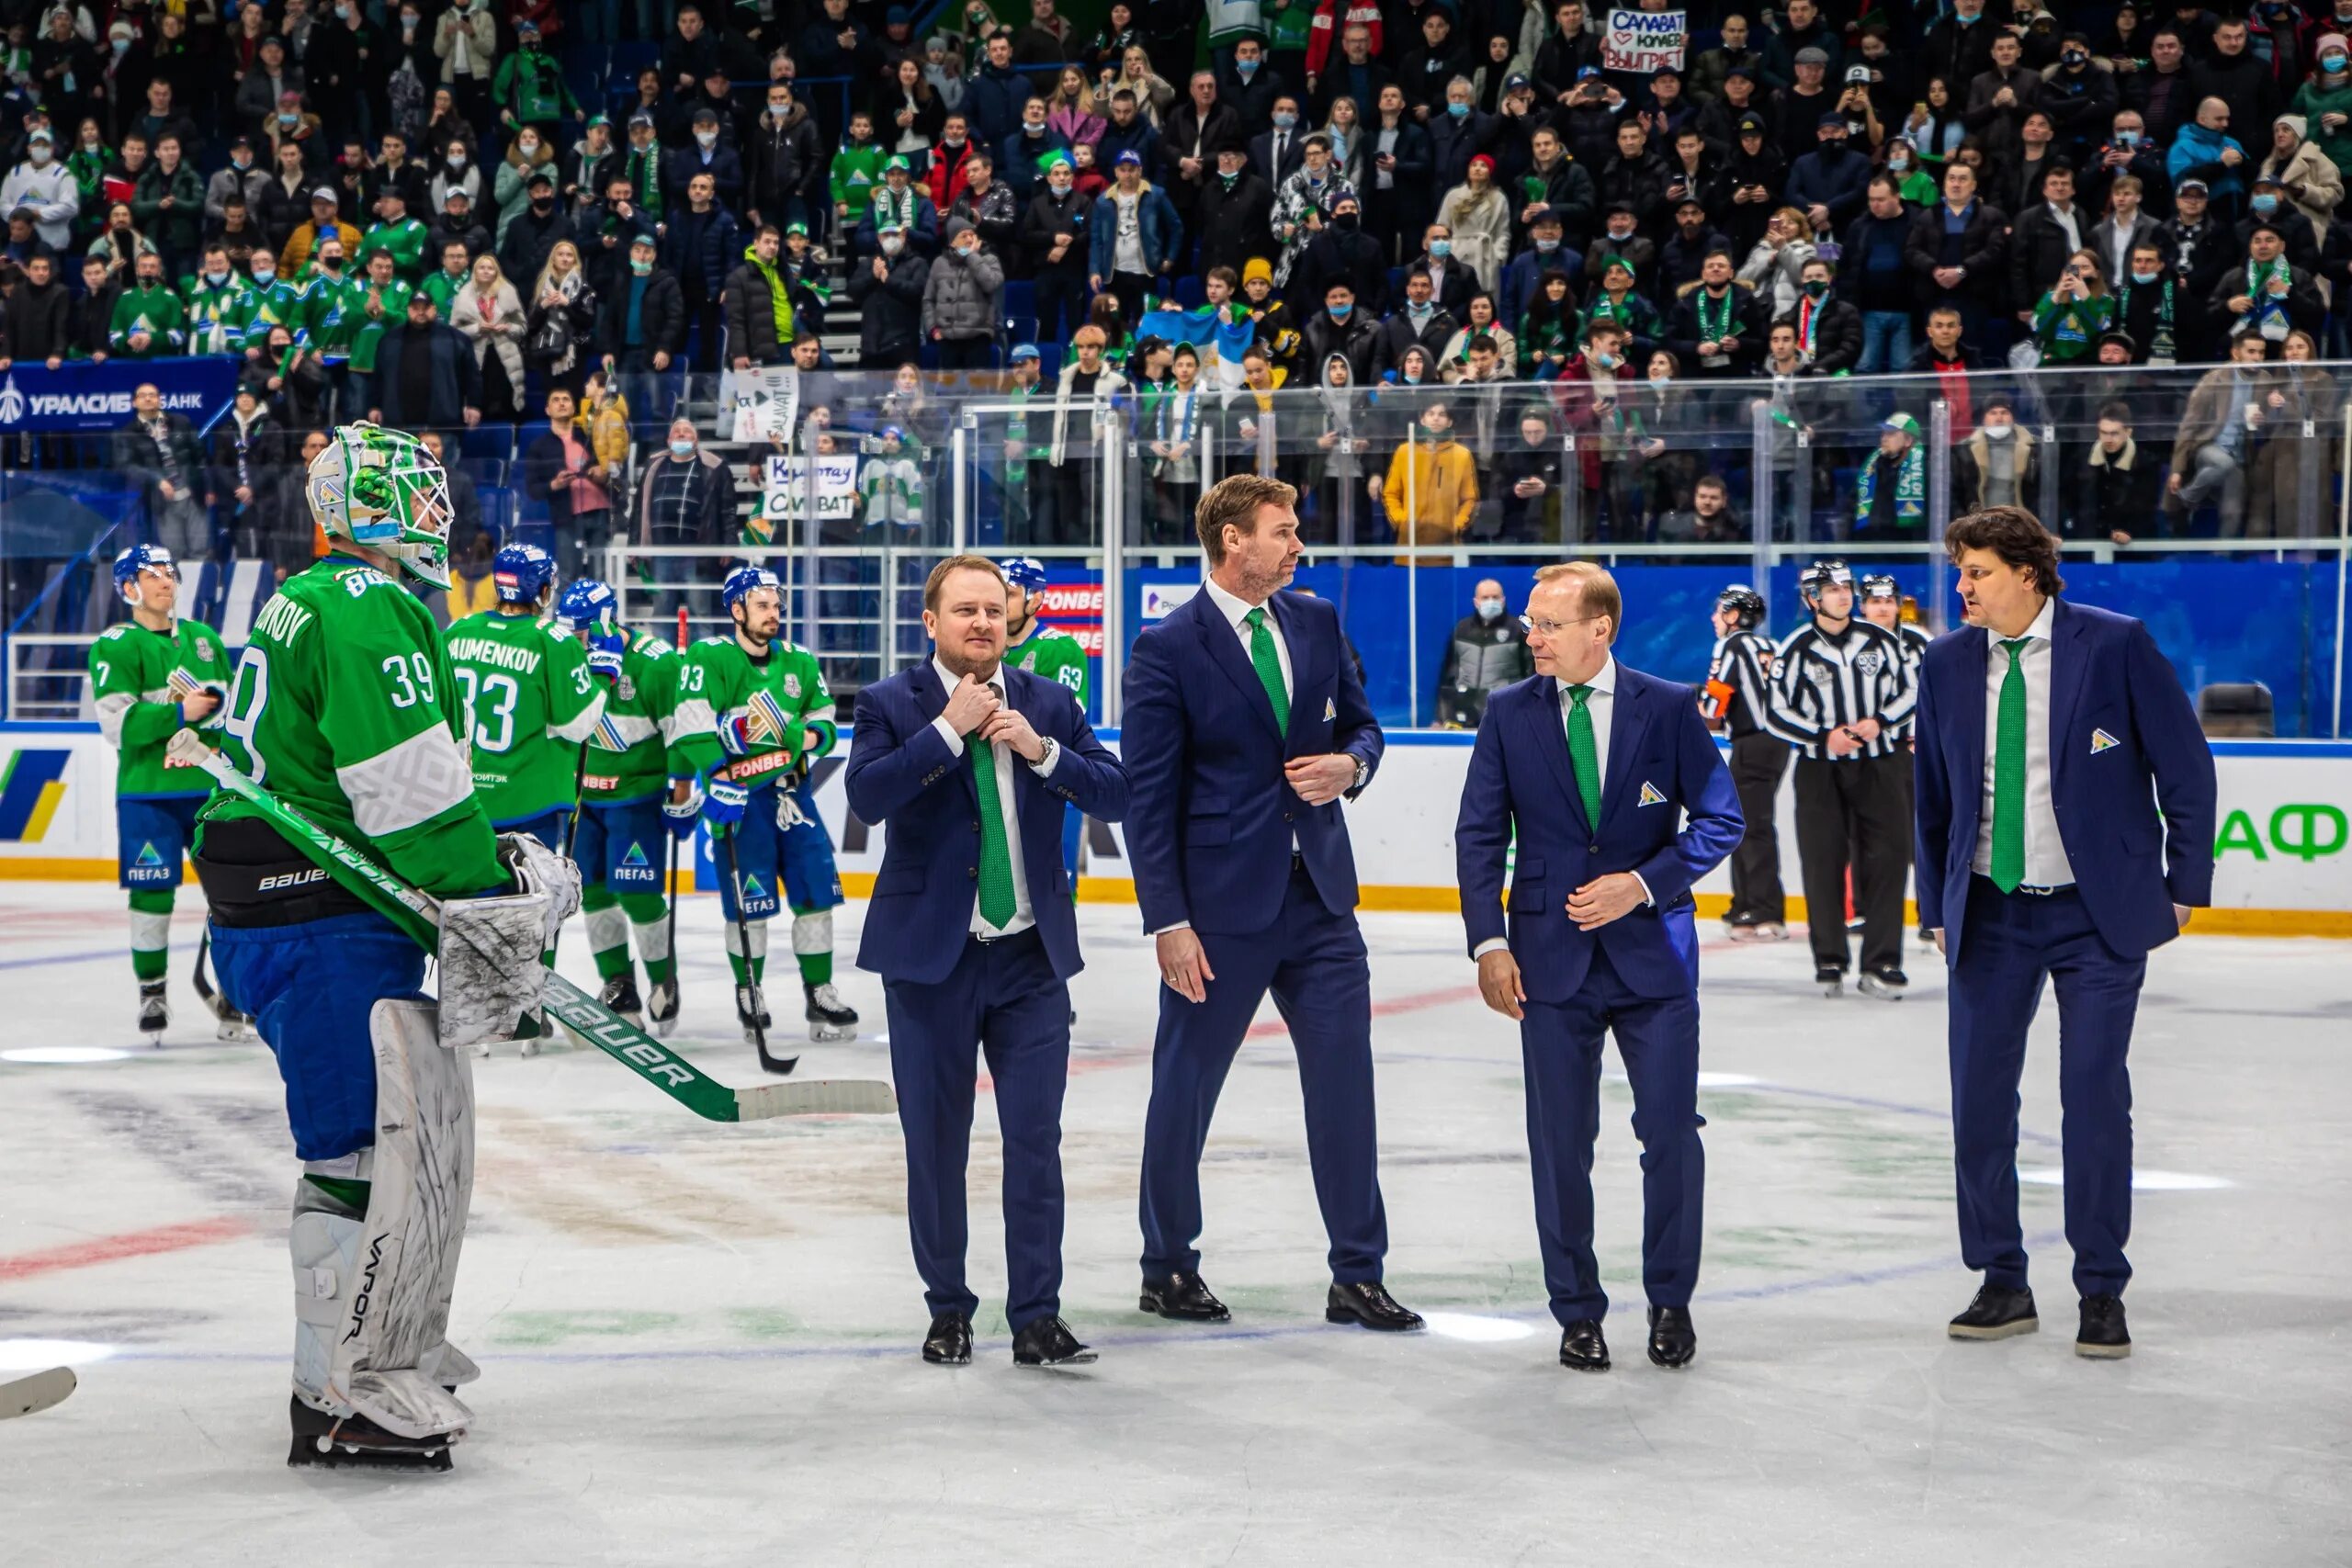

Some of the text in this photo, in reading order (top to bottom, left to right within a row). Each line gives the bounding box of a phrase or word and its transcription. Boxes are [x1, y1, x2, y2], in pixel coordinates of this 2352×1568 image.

[1612, 11, 1685, 32] САЛАВАТ
[29, 392, 202, 415] УРАЛСИБ БАНК
[381, 651, 435, 708] 39
[679, 664, 705, 691] 93
[1058, 665, 1082, 692] 63
[454, 667, 518, 752] 33
[730, 751, 792, 780] FONBET
[2213, 808, 2350, 863] АФ
[129, 867, 170, 881] ПЕГАЗ
[615, 868, 655, 881] ПЕГАЗ
[743, 898, 775, 914] ЕГАЗ
[341, 1232, 390, 1346] VAPOR
